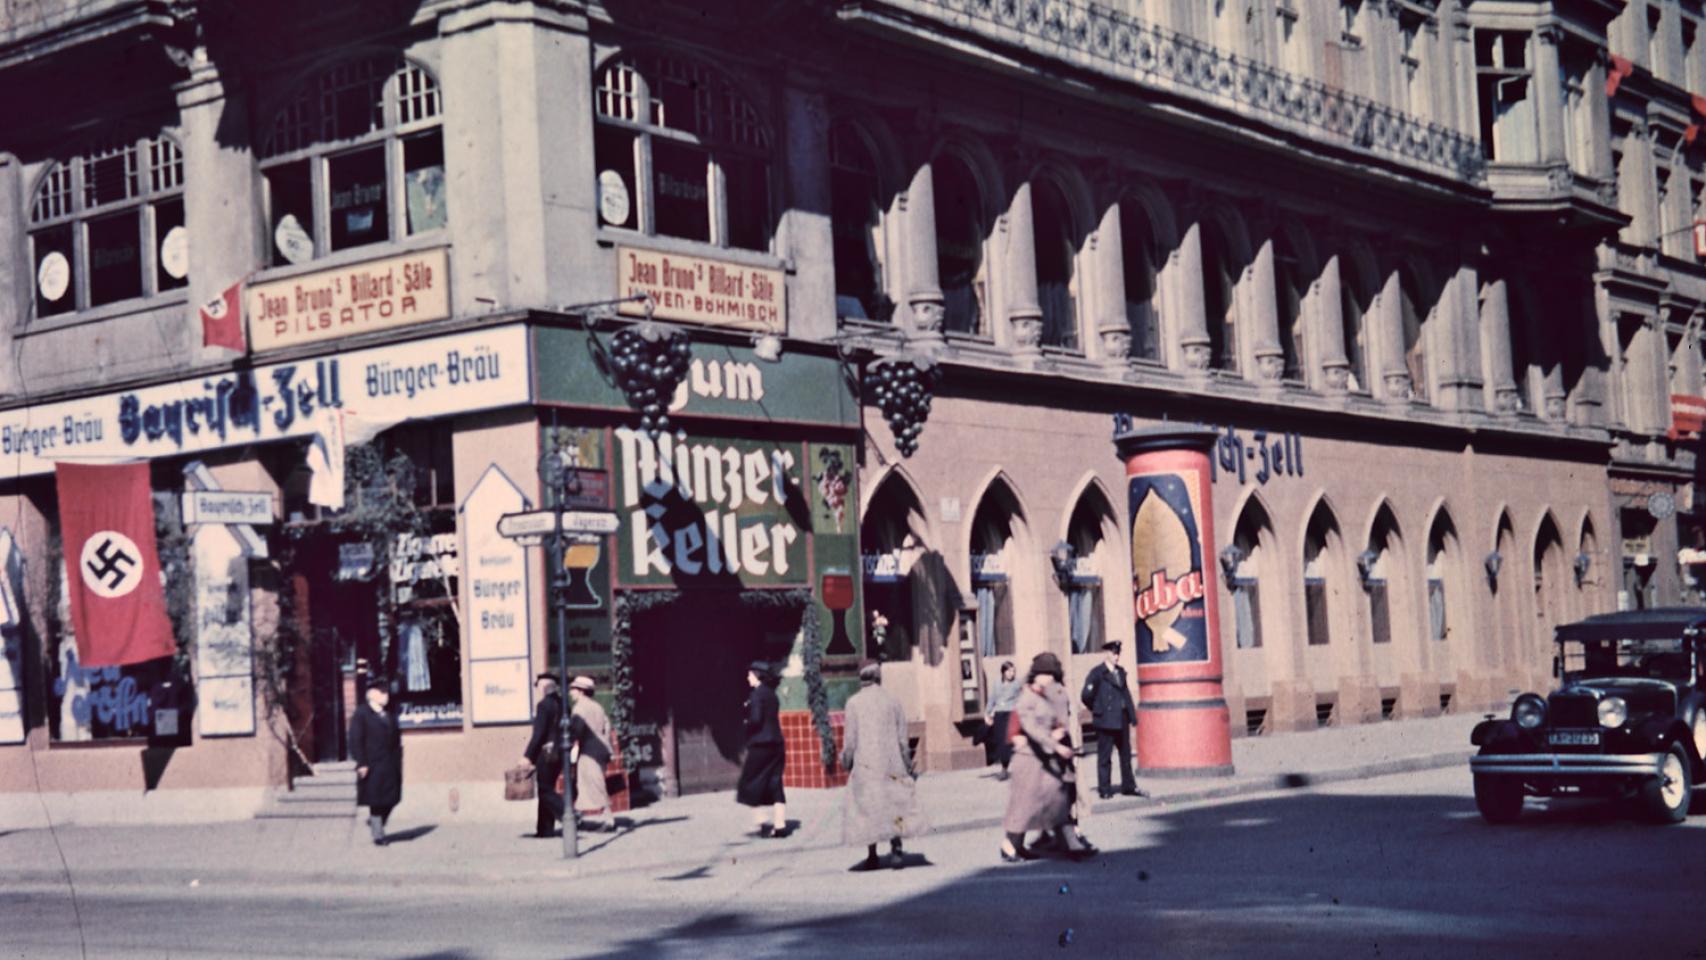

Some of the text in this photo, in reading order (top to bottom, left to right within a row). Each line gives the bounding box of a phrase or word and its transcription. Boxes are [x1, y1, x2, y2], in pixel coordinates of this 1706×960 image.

[628, 252, 657, 286] Jean
[258, 290, 289, 322] Jean
[274, 295, 417, 336] PILSATOR
[667, 357, 765, 413] um
[1136, 570, 1204, 618] aba
